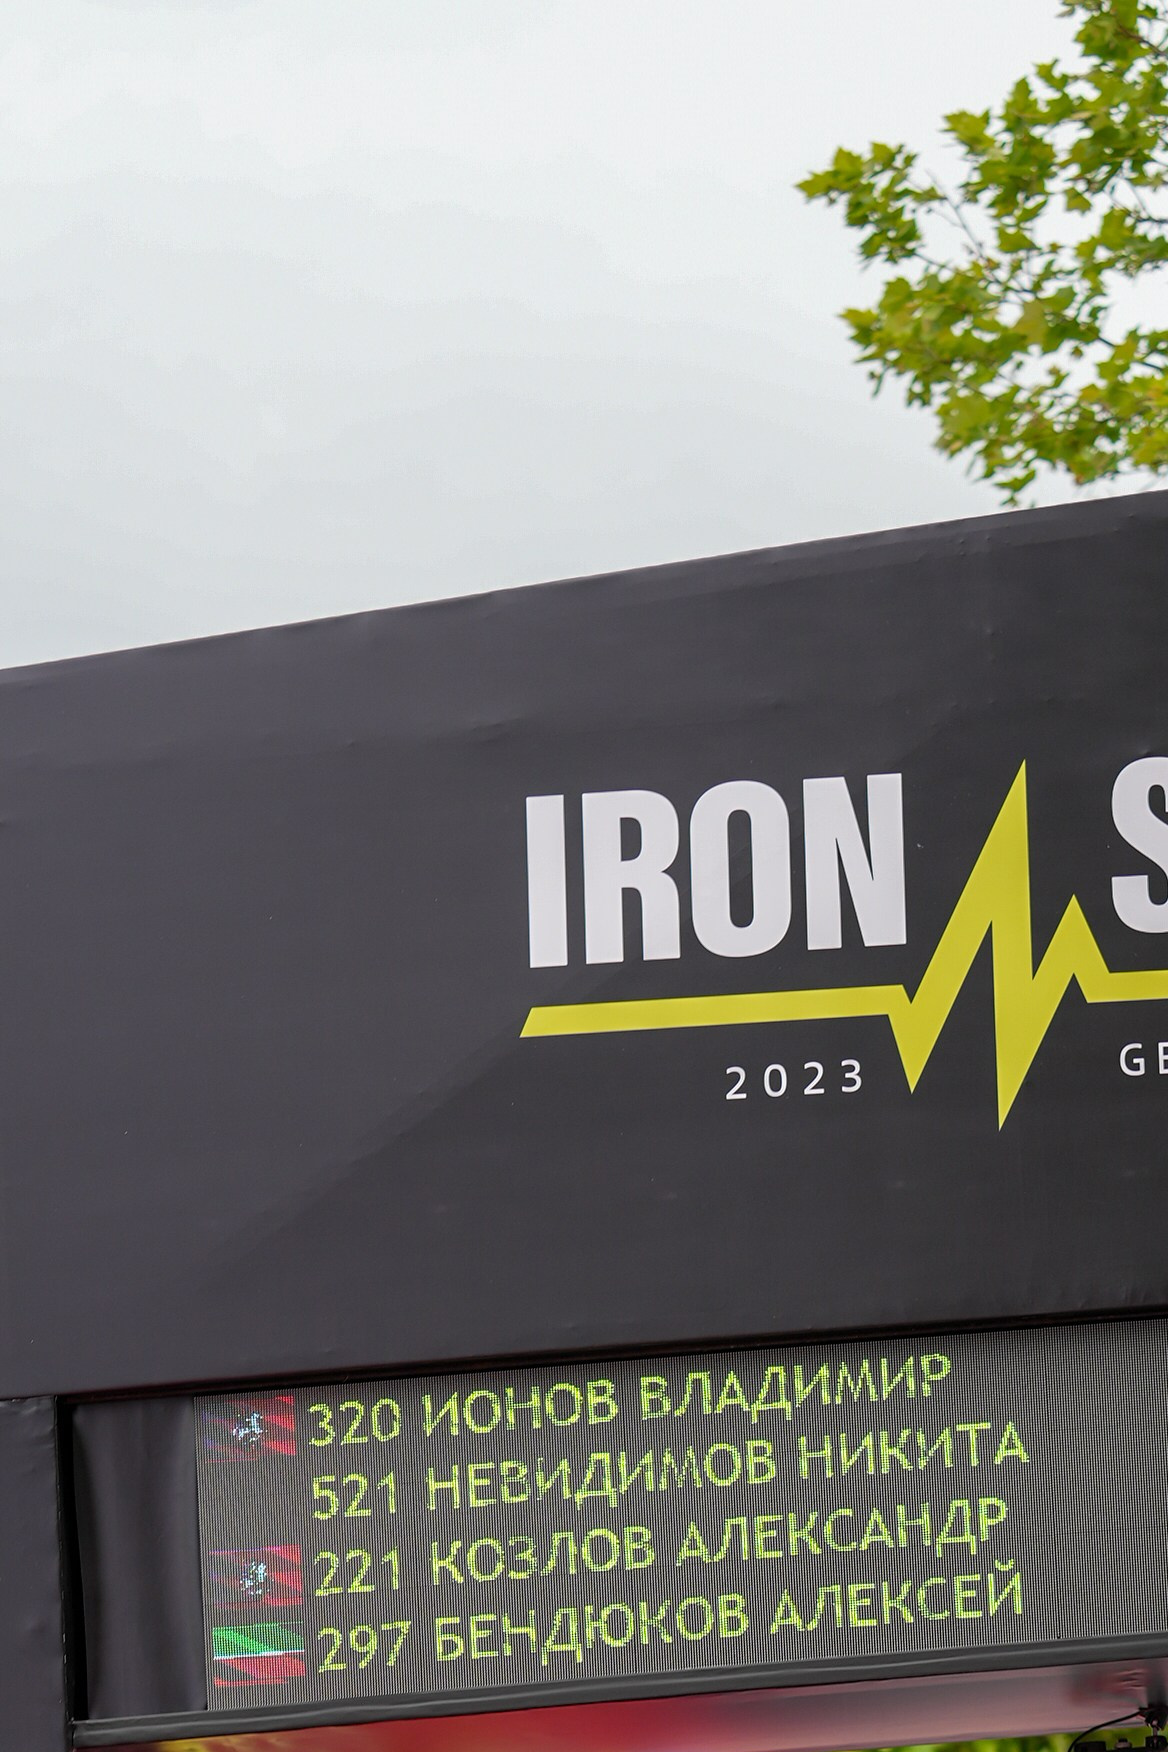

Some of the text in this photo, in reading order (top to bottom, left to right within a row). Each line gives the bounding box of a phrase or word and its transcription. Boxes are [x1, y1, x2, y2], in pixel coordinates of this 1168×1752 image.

[525, 772, 907, 968] IRON
[725, 1058, 863, 1101] 2023
[309, 1398, 401, 1447] 320
[423, 1379, 620, 1439] ИОНОВ
[641, 1353, 952, 1424] ВЛАДИМИР
[312, 1472, 397, 1521] 521
[427, 1441, 776, 1512] НЕВИДИМОВ
[800, 1421, 1030, 1480] НИКИТА
[314, 1547, 401, 1598] 221
[433, 1525, 655, 1587] КОЗЛОВ
[678, 1496, 1009, 1567] АЛЕКСАНДР
[318, 1620, 410, 1673] 297
[436, 1594, 747, 1665] БЕНДЮКОВ
[771, 1561, 1022, 1632] АЛЕКСЕЙ
